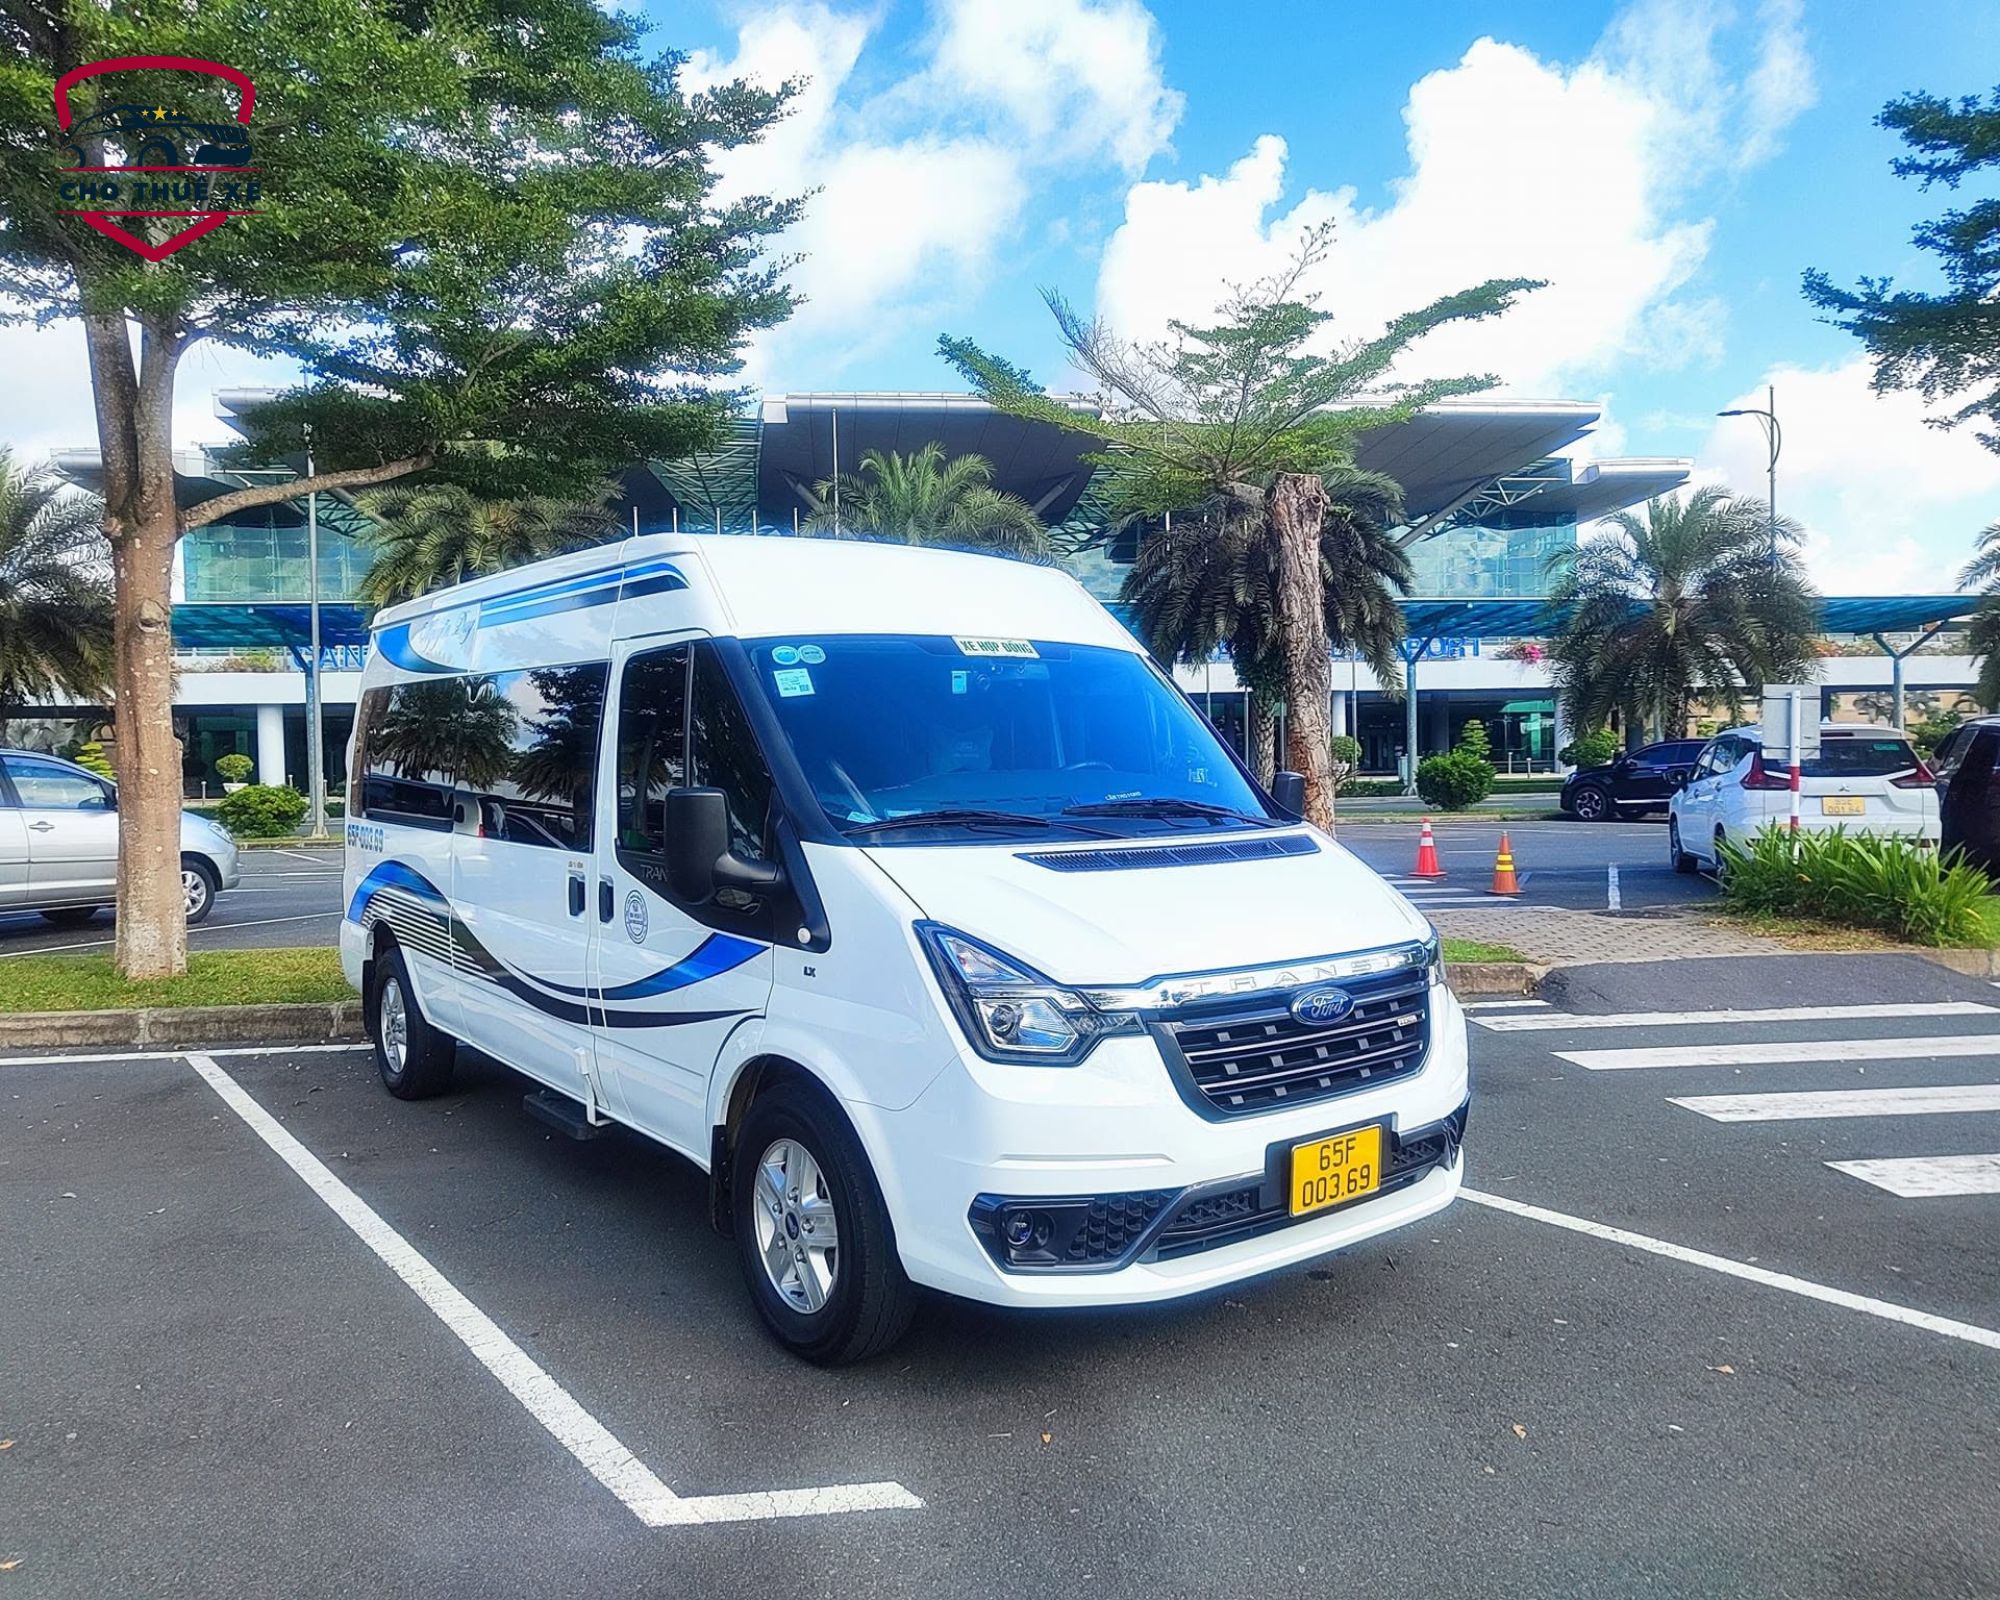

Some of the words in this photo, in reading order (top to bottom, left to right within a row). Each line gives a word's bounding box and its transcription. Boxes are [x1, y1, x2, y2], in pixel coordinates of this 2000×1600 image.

[960, 641, 977, 652] XE
[803, 965, 817, 978] LX
[1182, 950, 1417, 995] TRANSIT
[1311, 995, 1345, 1018] Ford
[1319, 1136, 1357, 1171] 65F
[1302, 1164, 1371, 1207] 003.69
